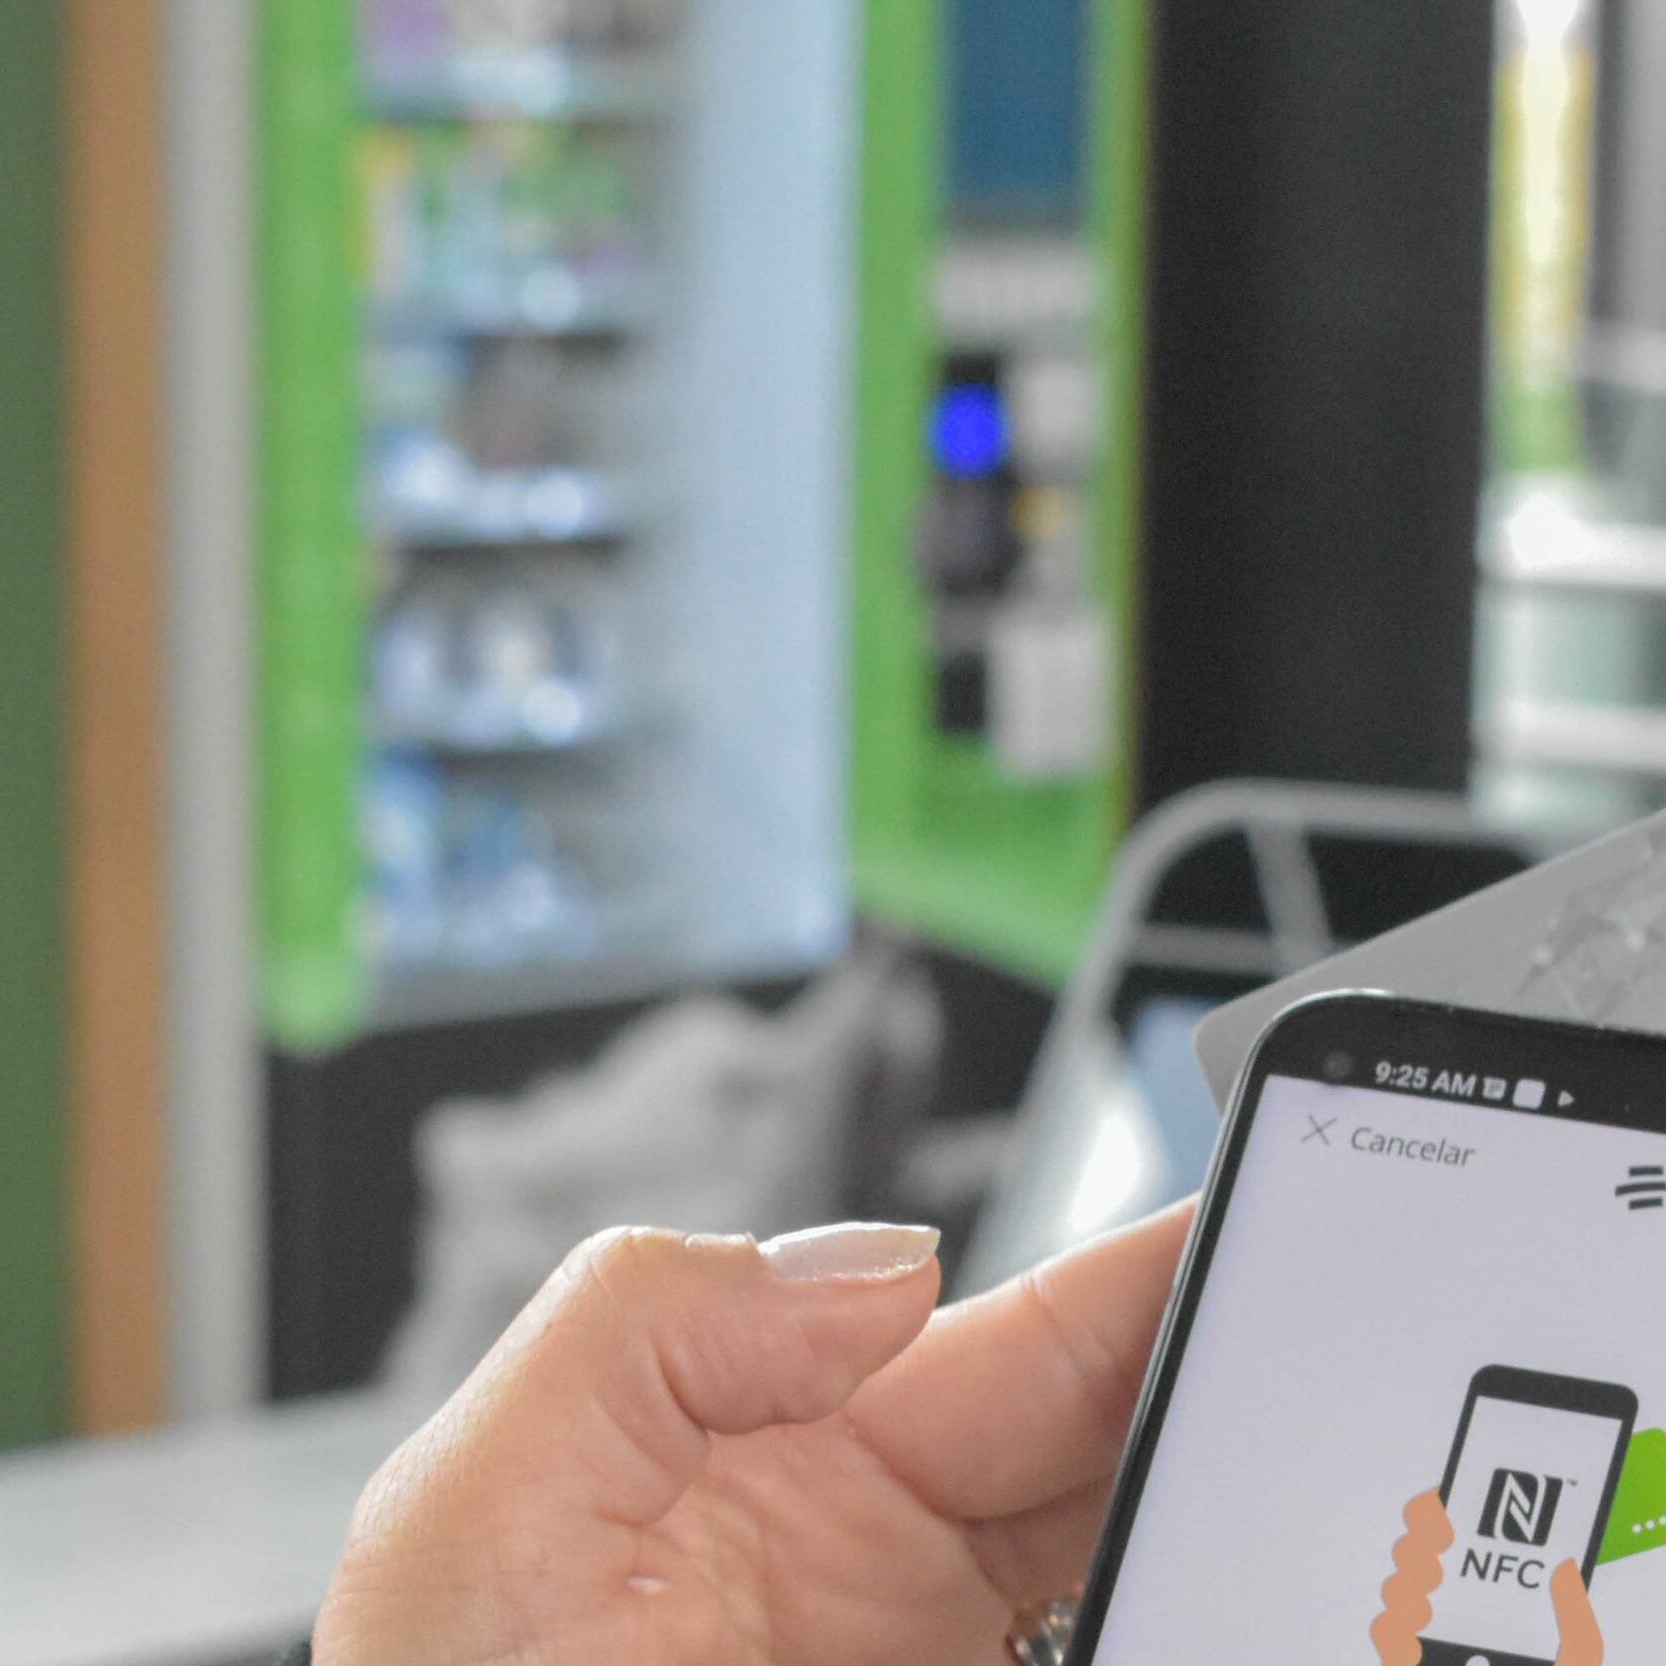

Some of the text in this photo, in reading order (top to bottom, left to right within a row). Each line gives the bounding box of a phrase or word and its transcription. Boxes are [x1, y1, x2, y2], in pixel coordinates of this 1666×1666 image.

[1374, 1060, 1478, 1098] 9:25 AM
[1350, 1126, 1477, 1167] Cancelar
[1459, 1547, 1546, 1589] NFC
